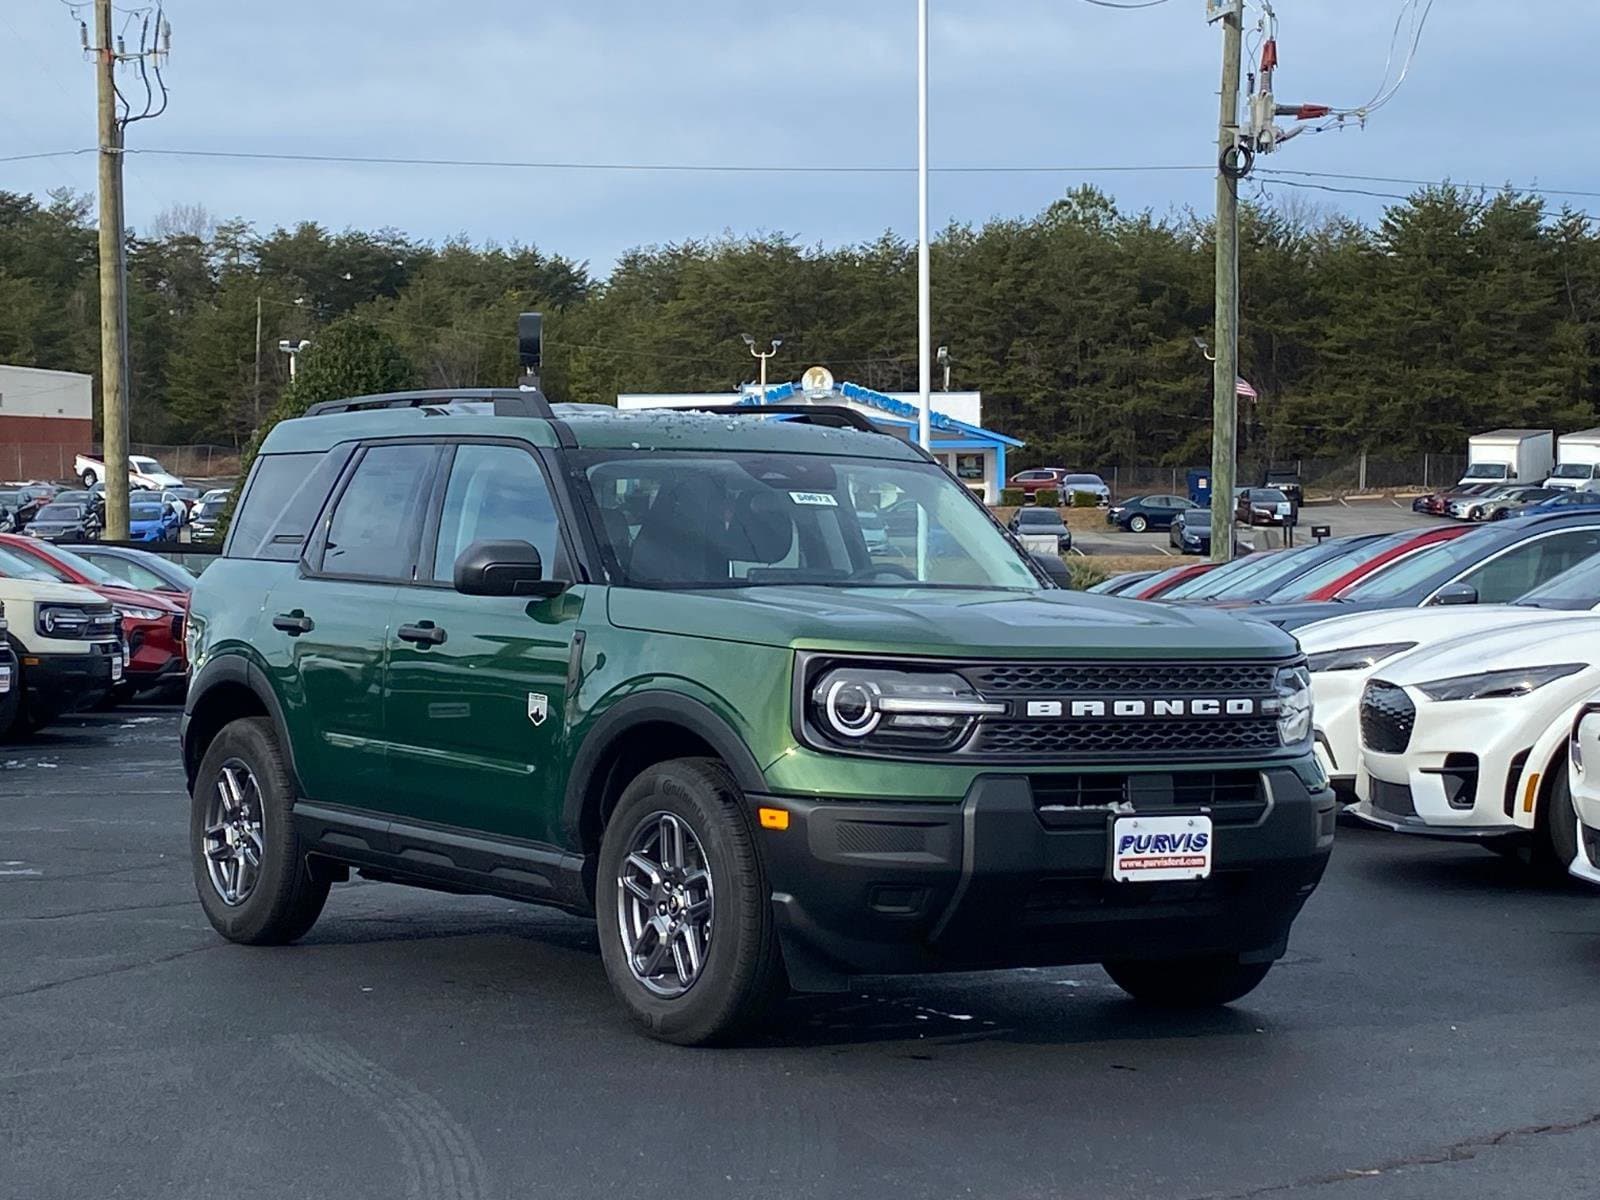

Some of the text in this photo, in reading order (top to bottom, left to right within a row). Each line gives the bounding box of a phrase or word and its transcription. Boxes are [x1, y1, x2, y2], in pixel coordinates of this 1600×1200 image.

[1027, 699, 1253, 716] BRONCO
[1118, 833, 1209, 854] PURVIS
[1121, 857, 1205, 868] www.purvisford.com
